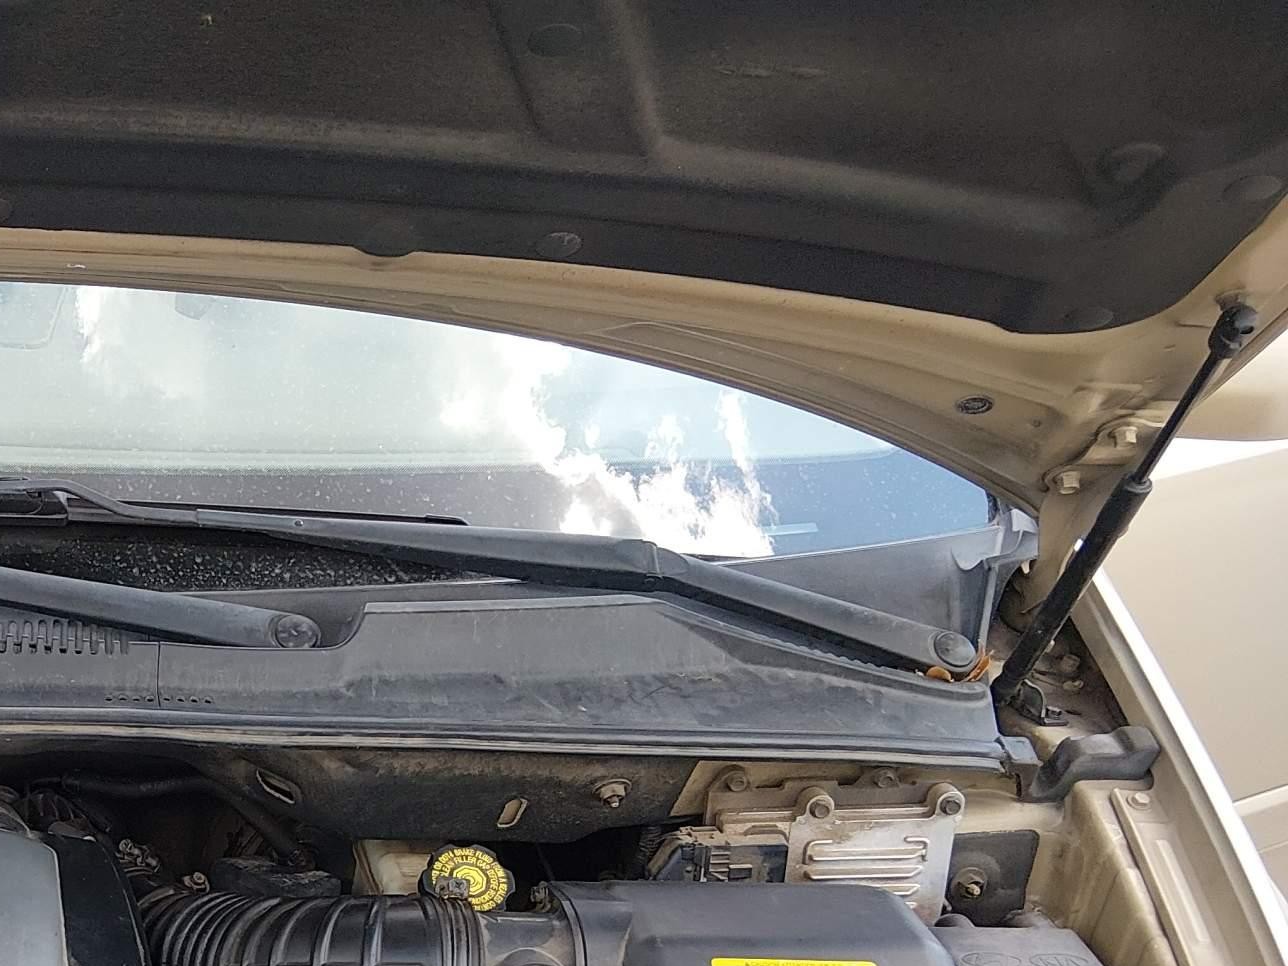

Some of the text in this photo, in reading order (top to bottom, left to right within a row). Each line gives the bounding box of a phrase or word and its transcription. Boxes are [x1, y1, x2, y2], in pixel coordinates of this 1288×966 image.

[454, 848, 475, 857] BRAKE
[475, 850, 493, 863] FLUID
[454, 856, 476, 865] FILLER
[477, 859, 491, 870] CAP
[487, 869, 499, 891] BEFORE
[491, 861, 505, 877] FROM
[494, 883, 508, 904] SEALED
